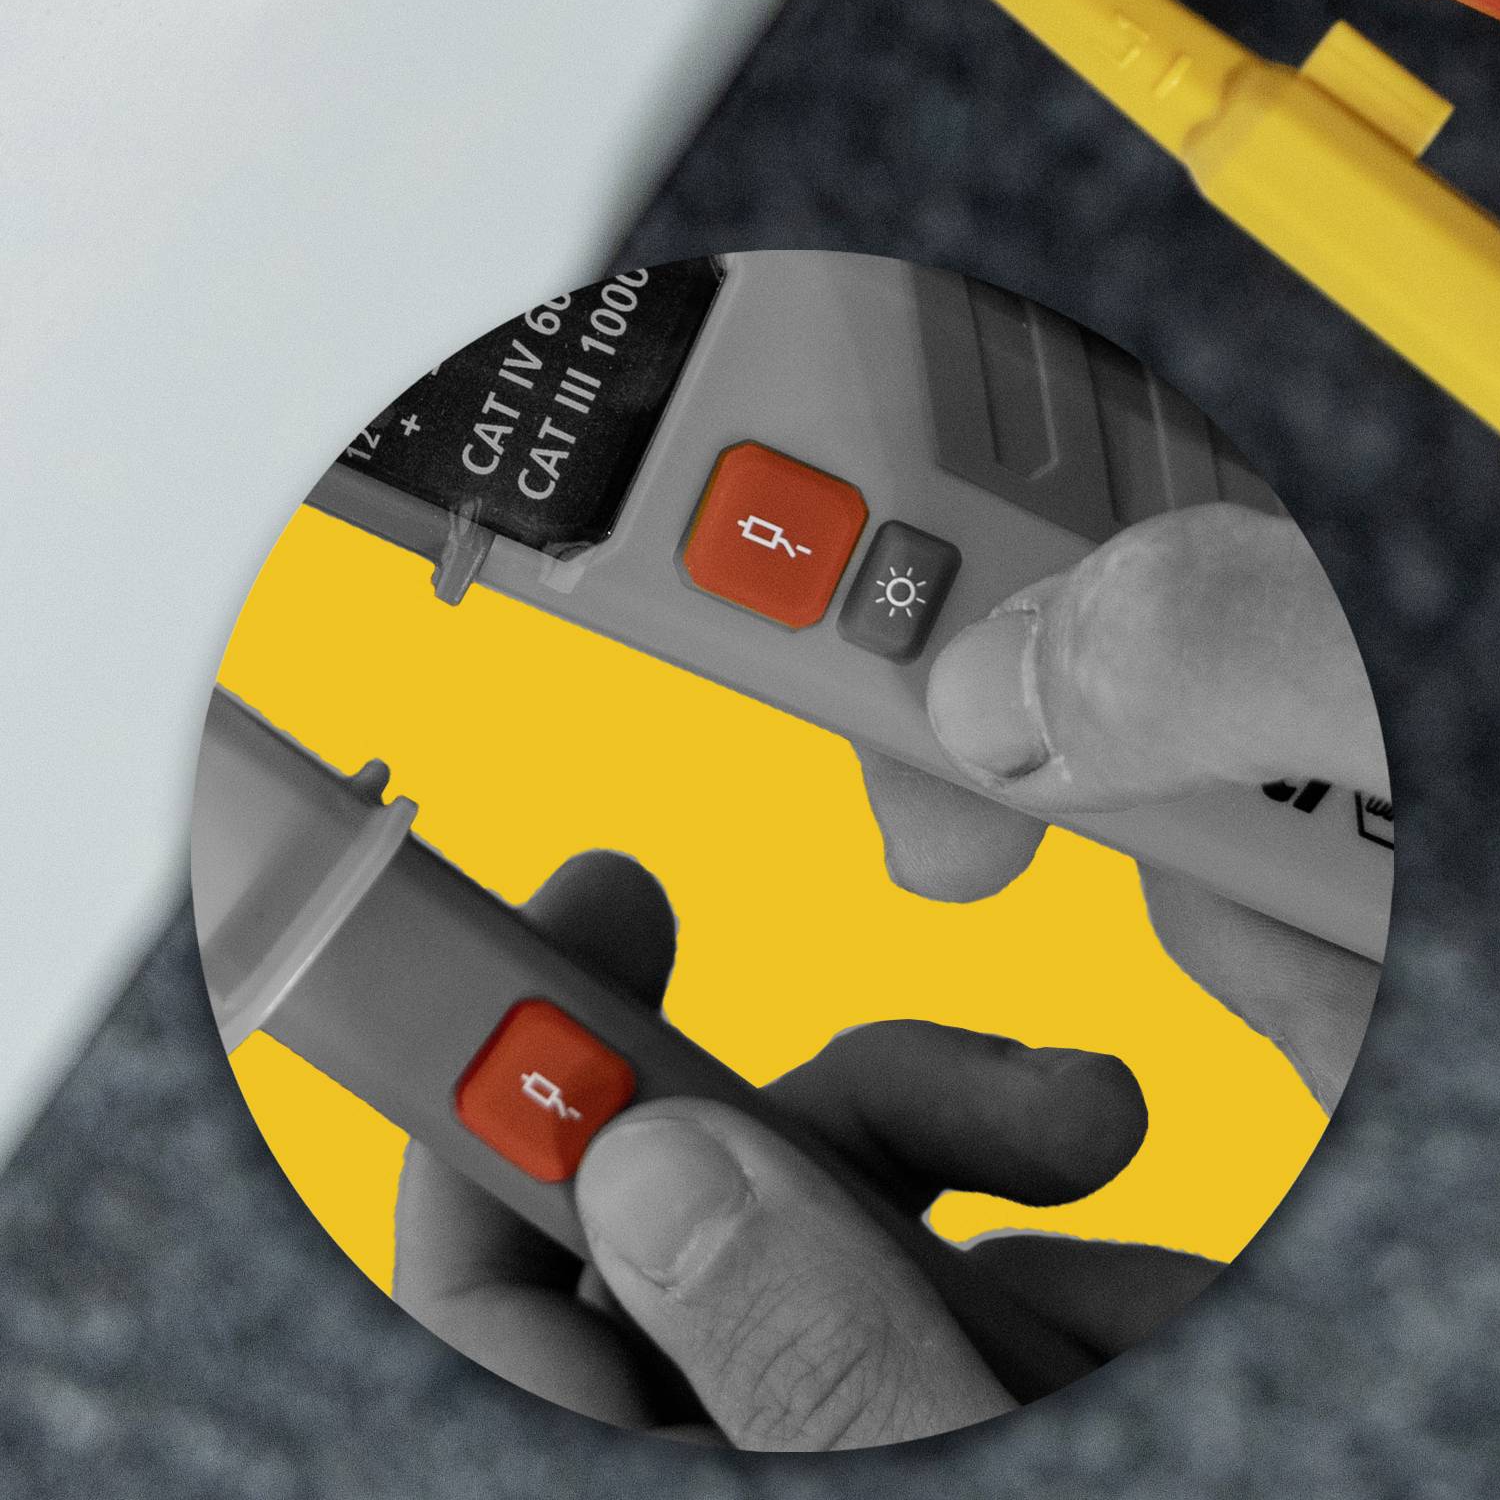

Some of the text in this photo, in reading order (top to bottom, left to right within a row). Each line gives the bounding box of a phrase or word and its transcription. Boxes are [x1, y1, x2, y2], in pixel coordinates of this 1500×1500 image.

[462, 391, 520, 475] CAT
[499, 339, 543, 389] IV
[517, 416, 576, 501] CAT
[554, 367, 601, 414] III
